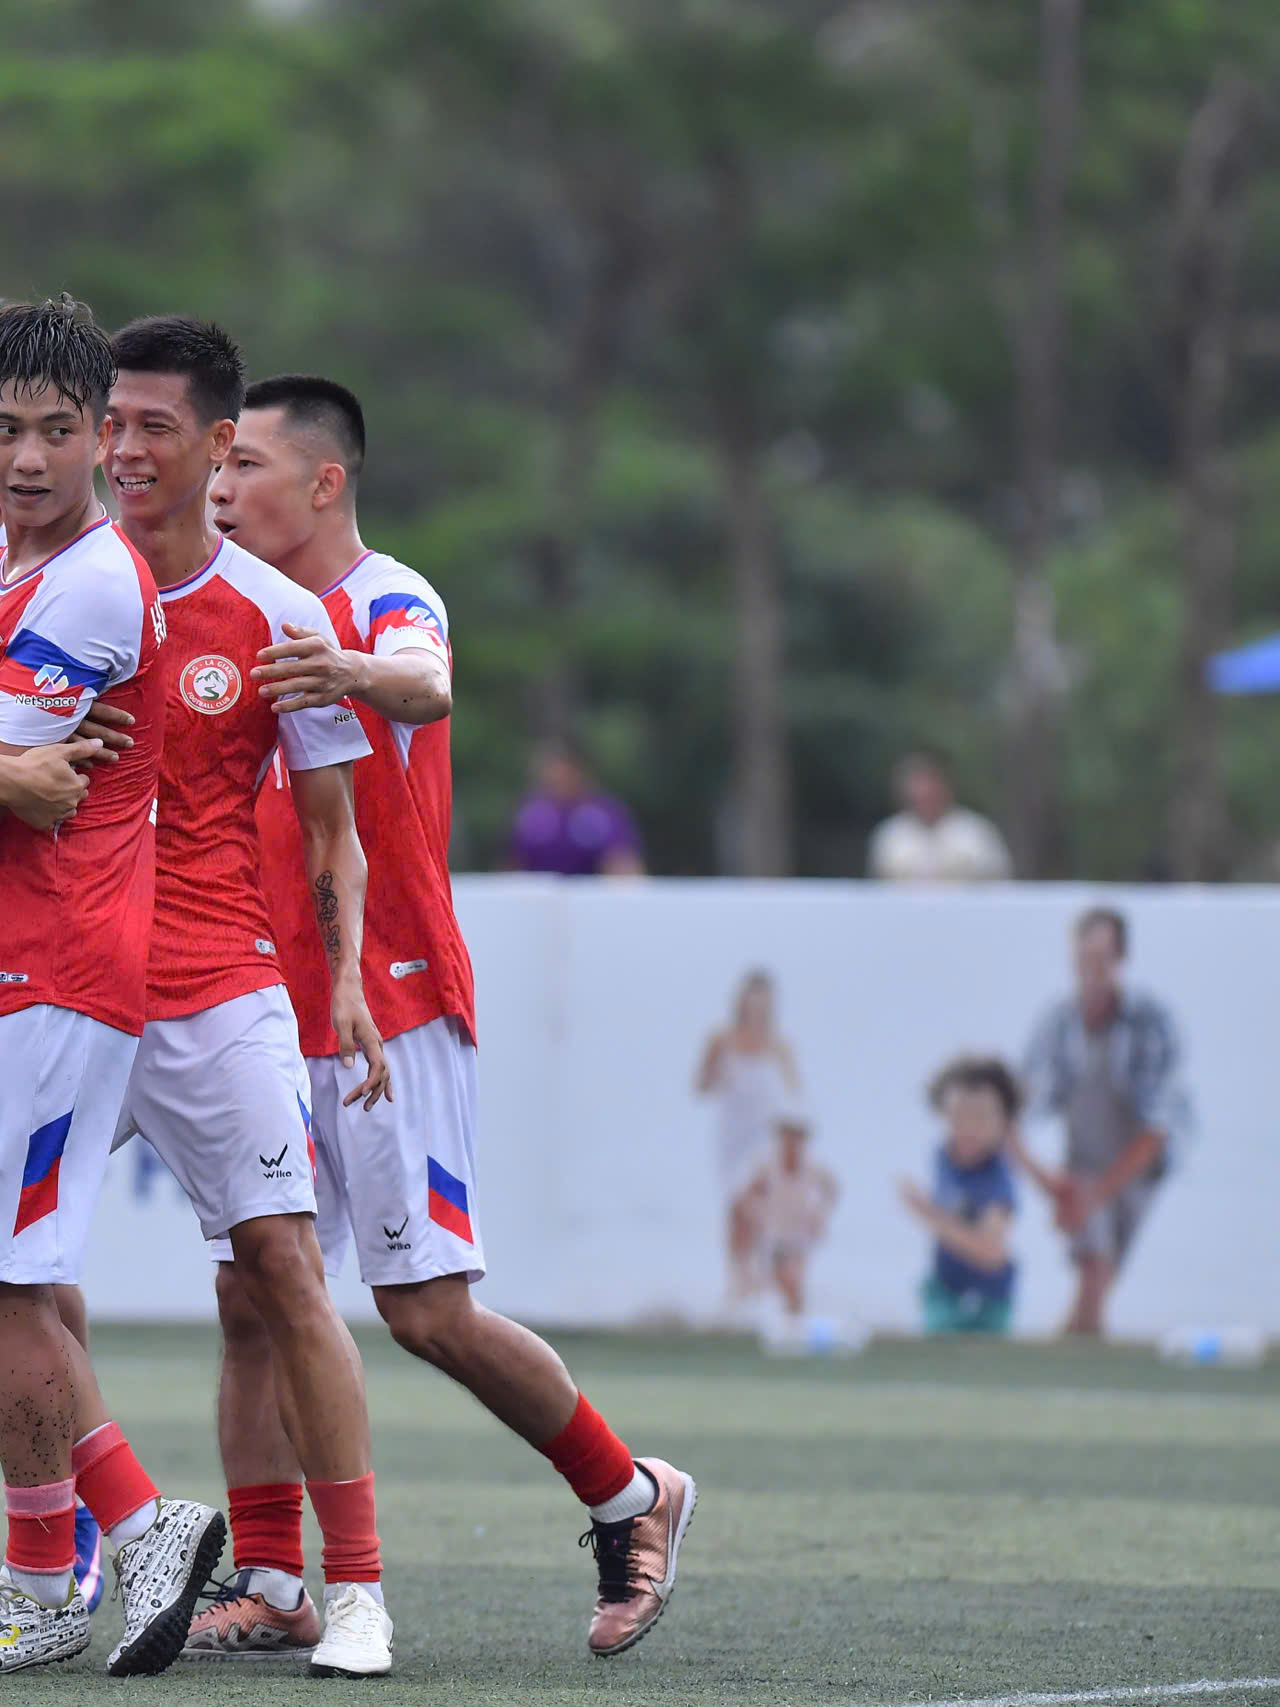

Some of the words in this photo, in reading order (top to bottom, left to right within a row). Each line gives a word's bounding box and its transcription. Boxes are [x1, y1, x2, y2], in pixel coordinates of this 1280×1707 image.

[15, 694, 77, 708] NetSpace
[187, 691, 214, 708] FOOTBALL
[215, 696, 231, 708] CLUB
